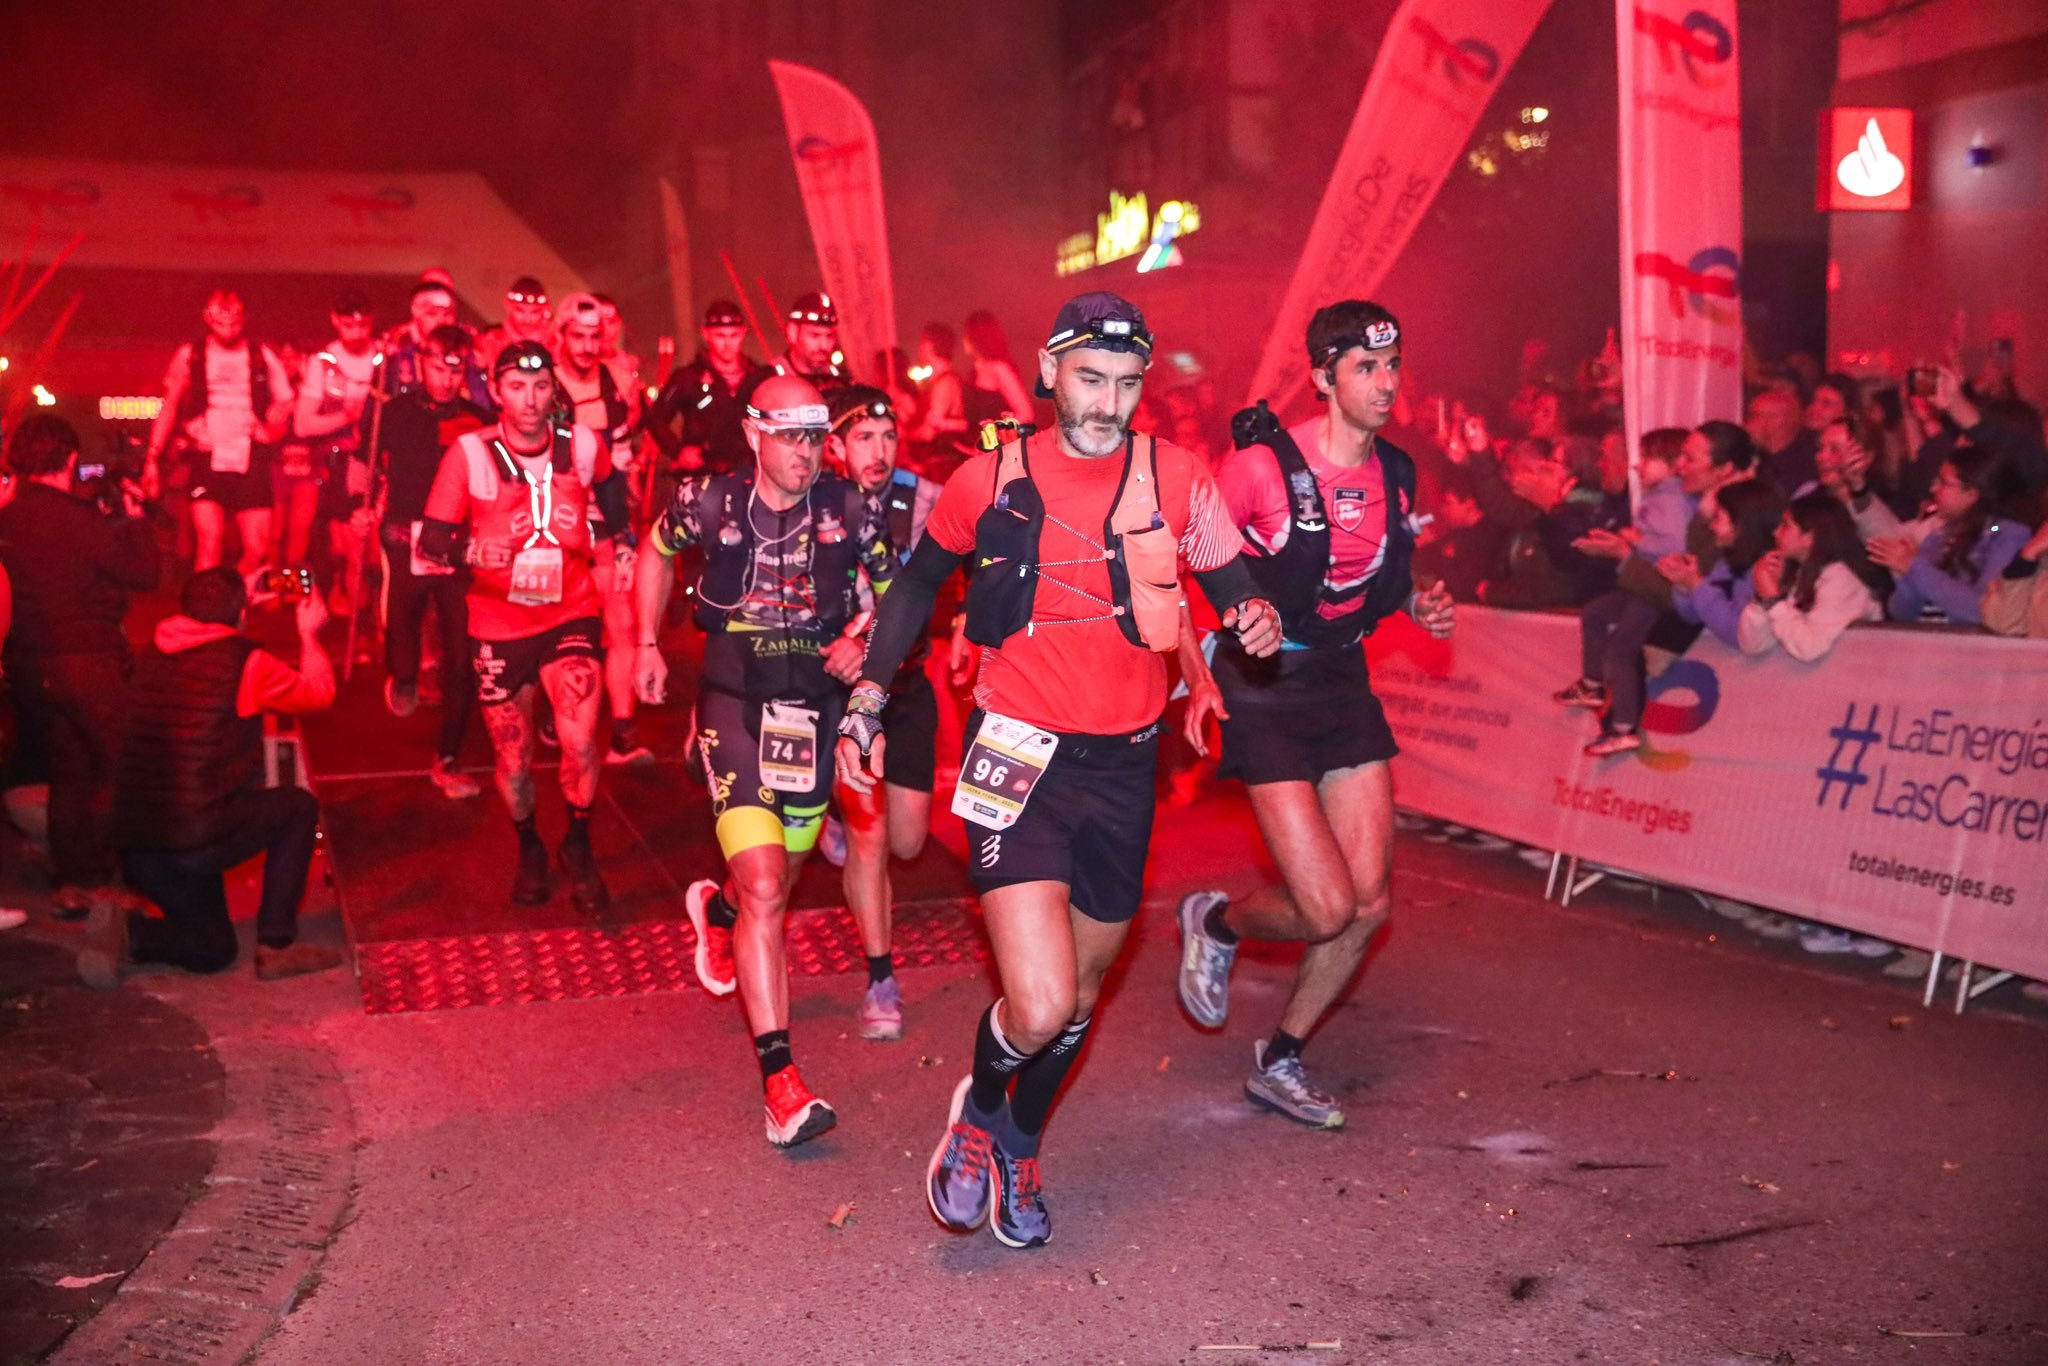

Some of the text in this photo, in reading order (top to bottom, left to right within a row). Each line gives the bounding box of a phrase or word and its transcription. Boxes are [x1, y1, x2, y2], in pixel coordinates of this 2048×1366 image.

[770, 741, 794, 761] 74
[973, 758, 1009, 787] 96
[1552, 776, 1694, 835] TotalEnergies
[1848, 851, 2016, 907] totalenergies.es
